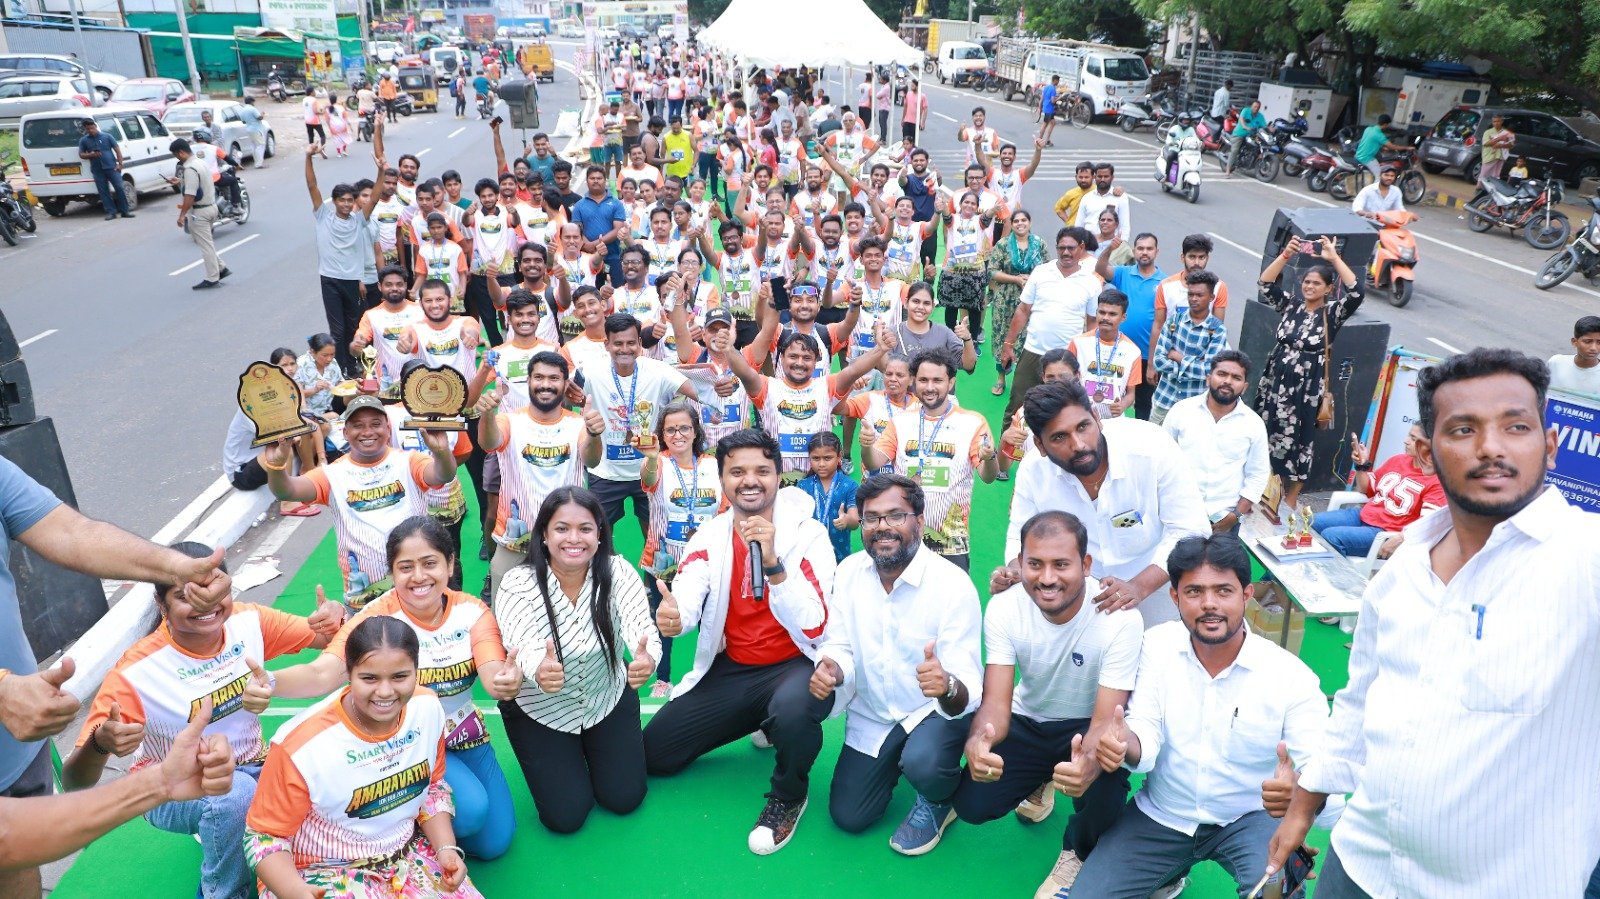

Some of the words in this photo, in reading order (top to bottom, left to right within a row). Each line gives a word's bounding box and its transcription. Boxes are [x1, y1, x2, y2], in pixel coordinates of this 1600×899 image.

[1562, 407, 1594, 420] YAMAHA
[618, 447, 635, 455] 1124
[1551, 422, 1600, 458] VIN
[1373, 471, 1425, 516] 95
[176, 660, 214, 681] SMART
[213, 640, 246, 665] VISION
[346, 743, 386, 764] SMART
[386, 727, 421, 749] VISION
[345, 758, 431, 813] AMARAVATHI
